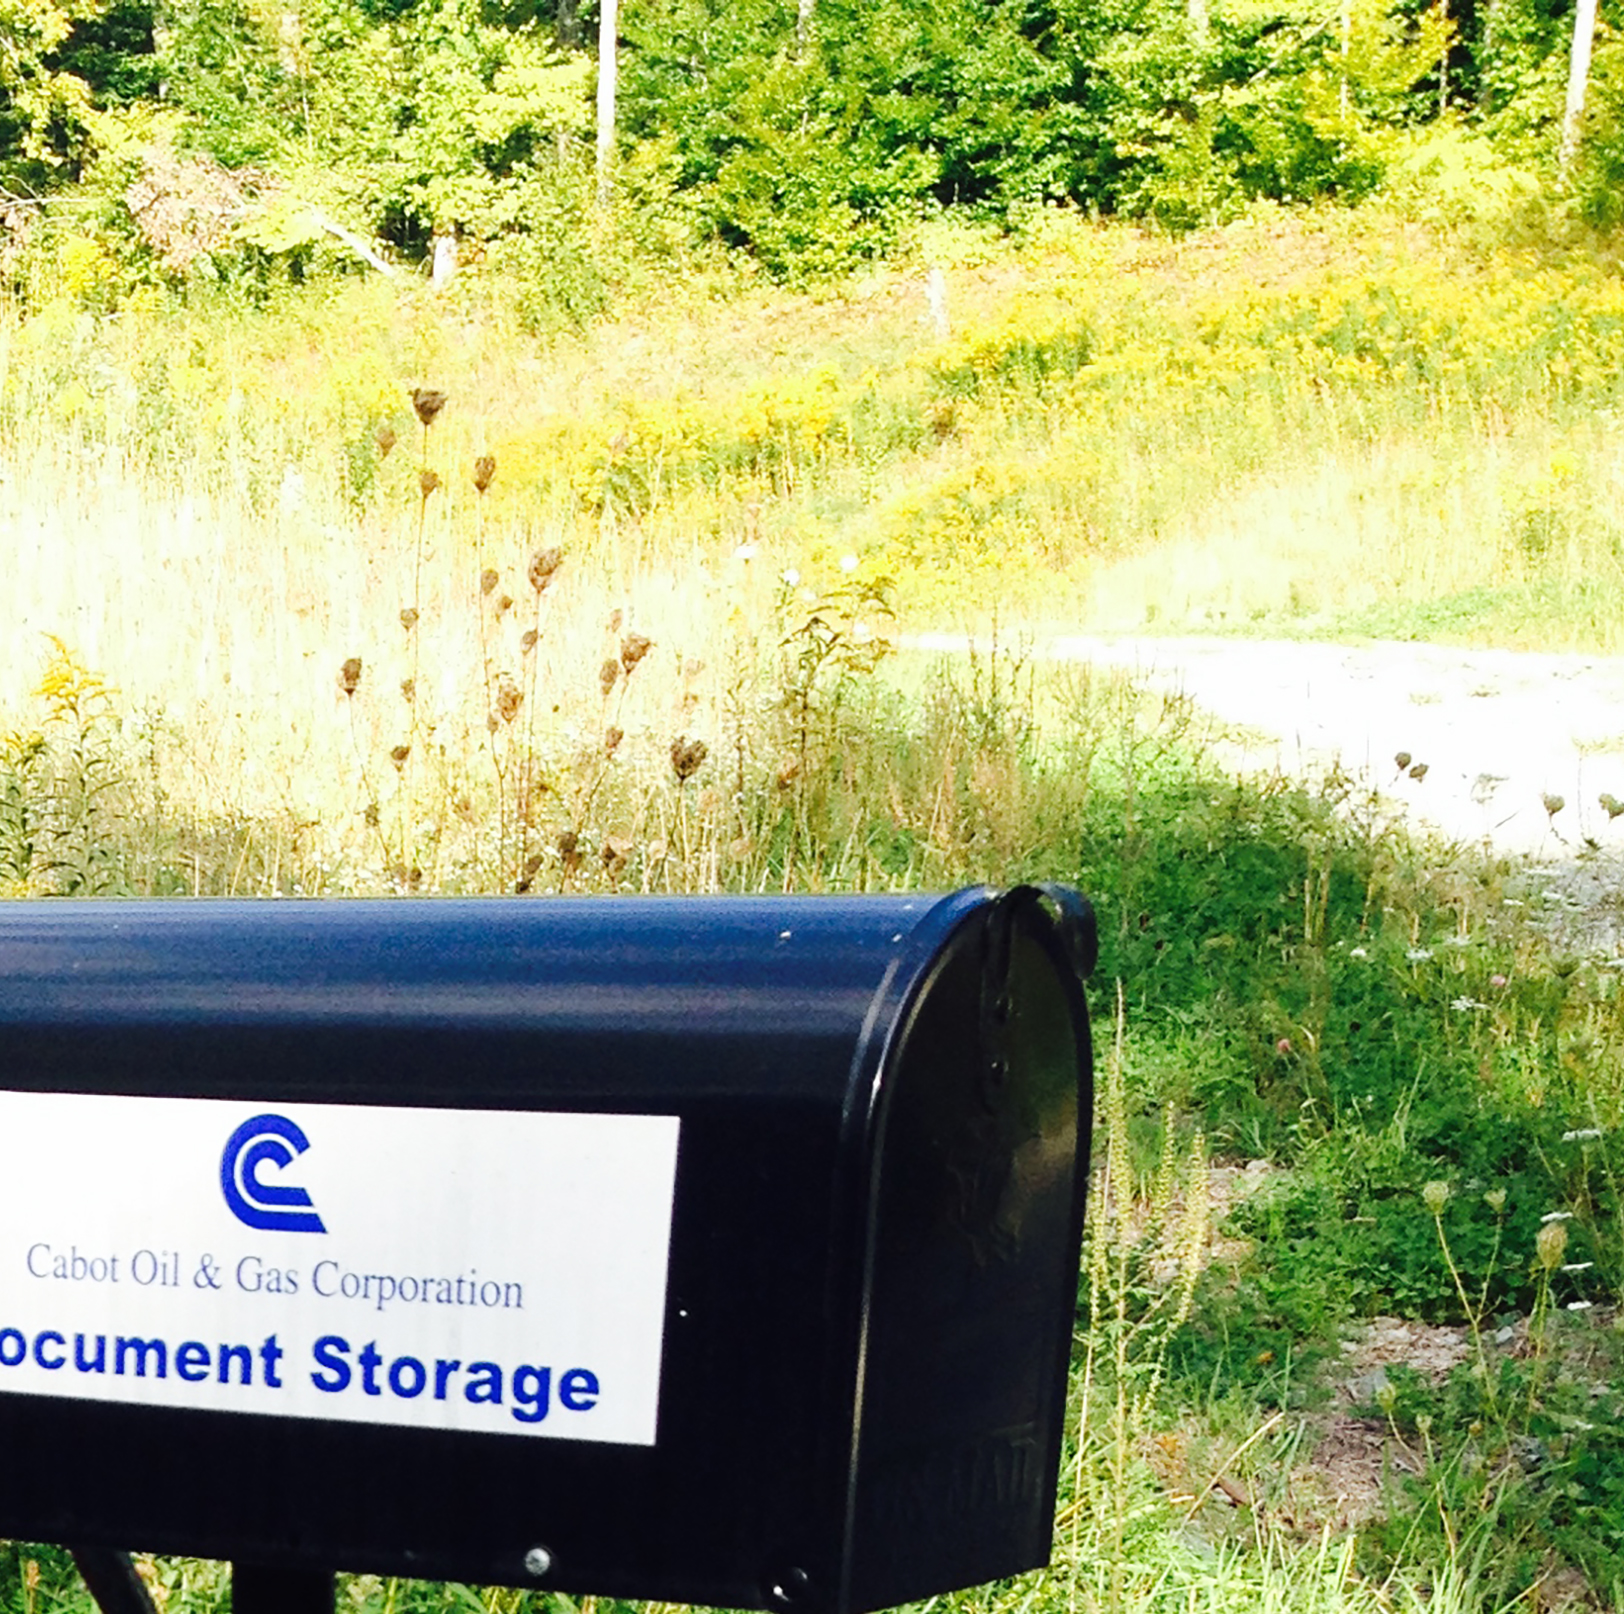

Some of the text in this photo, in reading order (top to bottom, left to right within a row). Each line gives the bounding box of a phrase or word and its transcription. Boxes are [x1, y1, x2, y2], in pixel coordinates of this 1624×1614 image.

[28, 1244, 524, 1311] Cabot Oil & Gas Corporation
[311, 1334, 601, 1423] Storage
